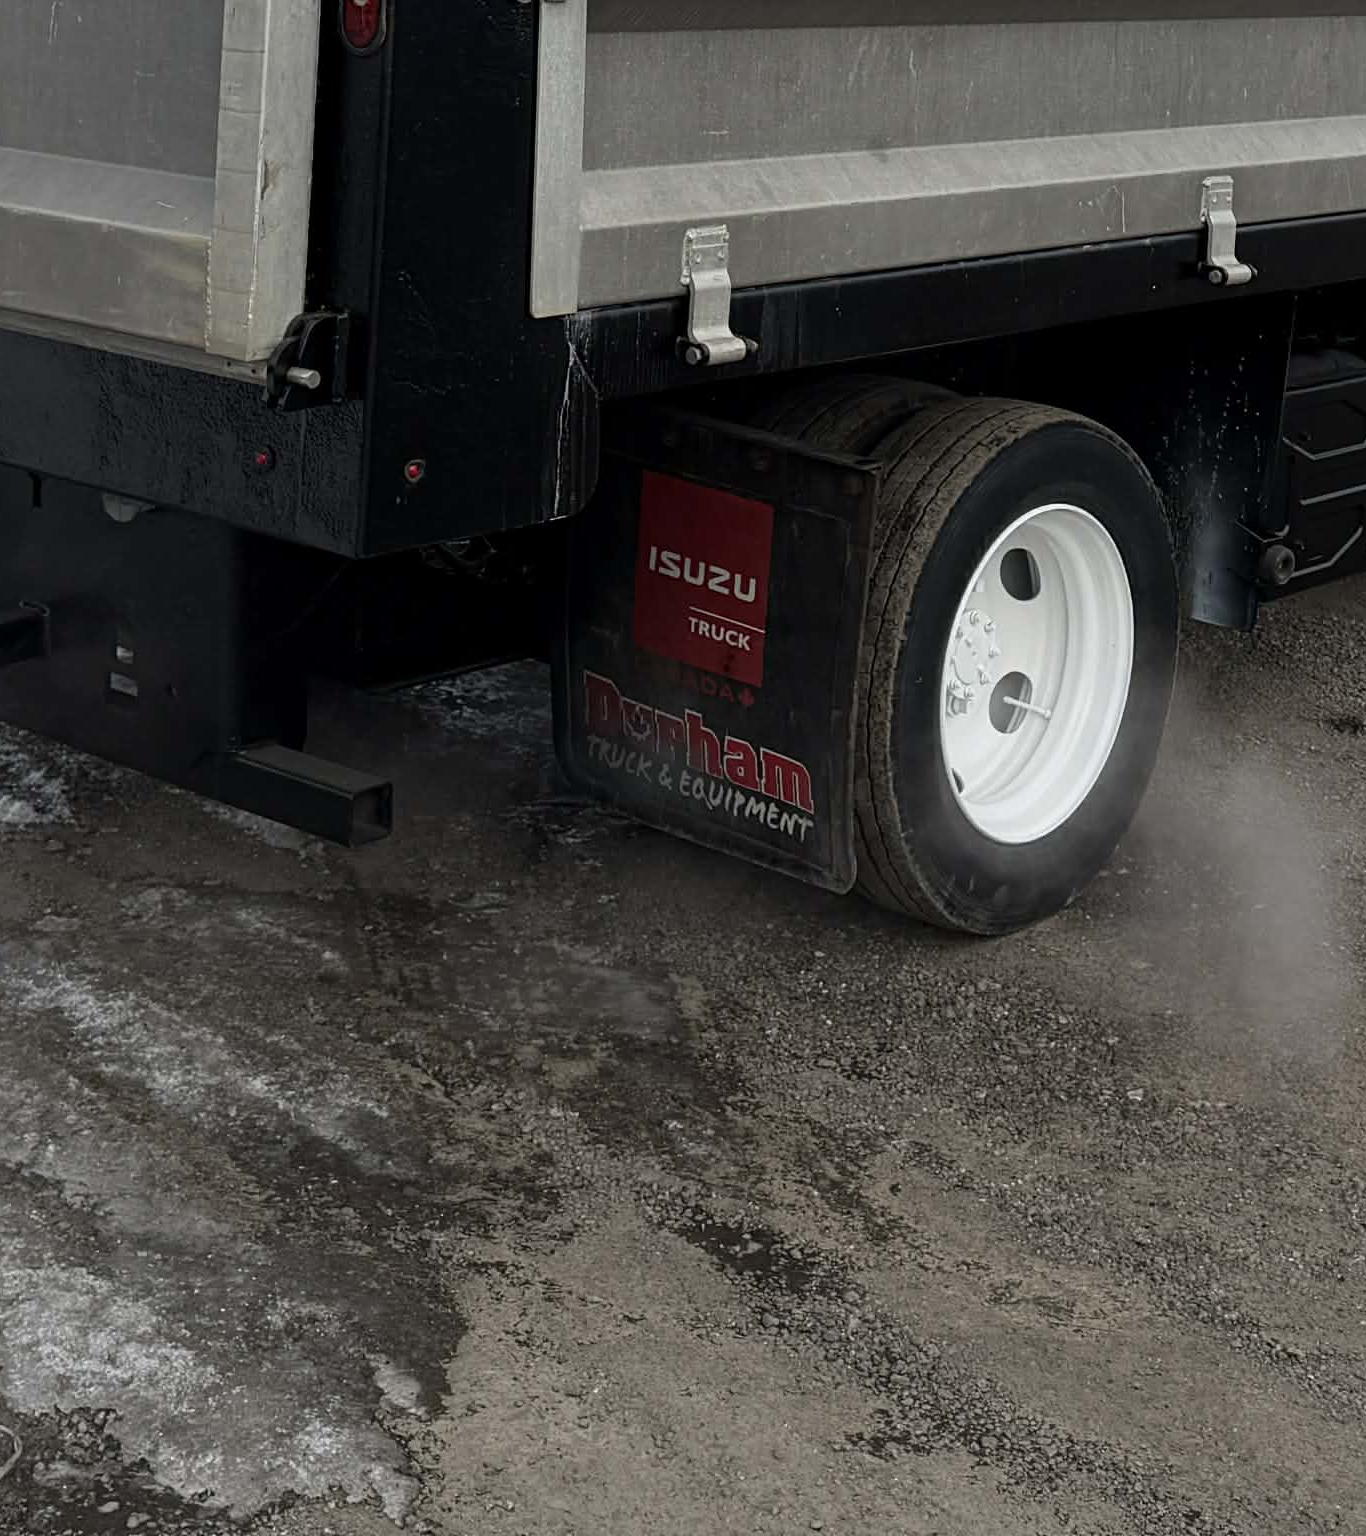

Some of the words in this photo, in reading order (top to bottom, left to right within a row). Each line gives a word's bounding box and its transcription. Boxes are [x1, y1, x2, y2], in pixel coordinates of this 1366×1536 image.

[649, 546, 756, 602] ISUZU
[688, 616, 751, 651] TRUCK
[584, 670, 815, 814] Durham
[587, 735, 652, 782] TRUCK
[658, 766, 673, 791] &
[679, 770, 815, 842] EQUIPMENT
